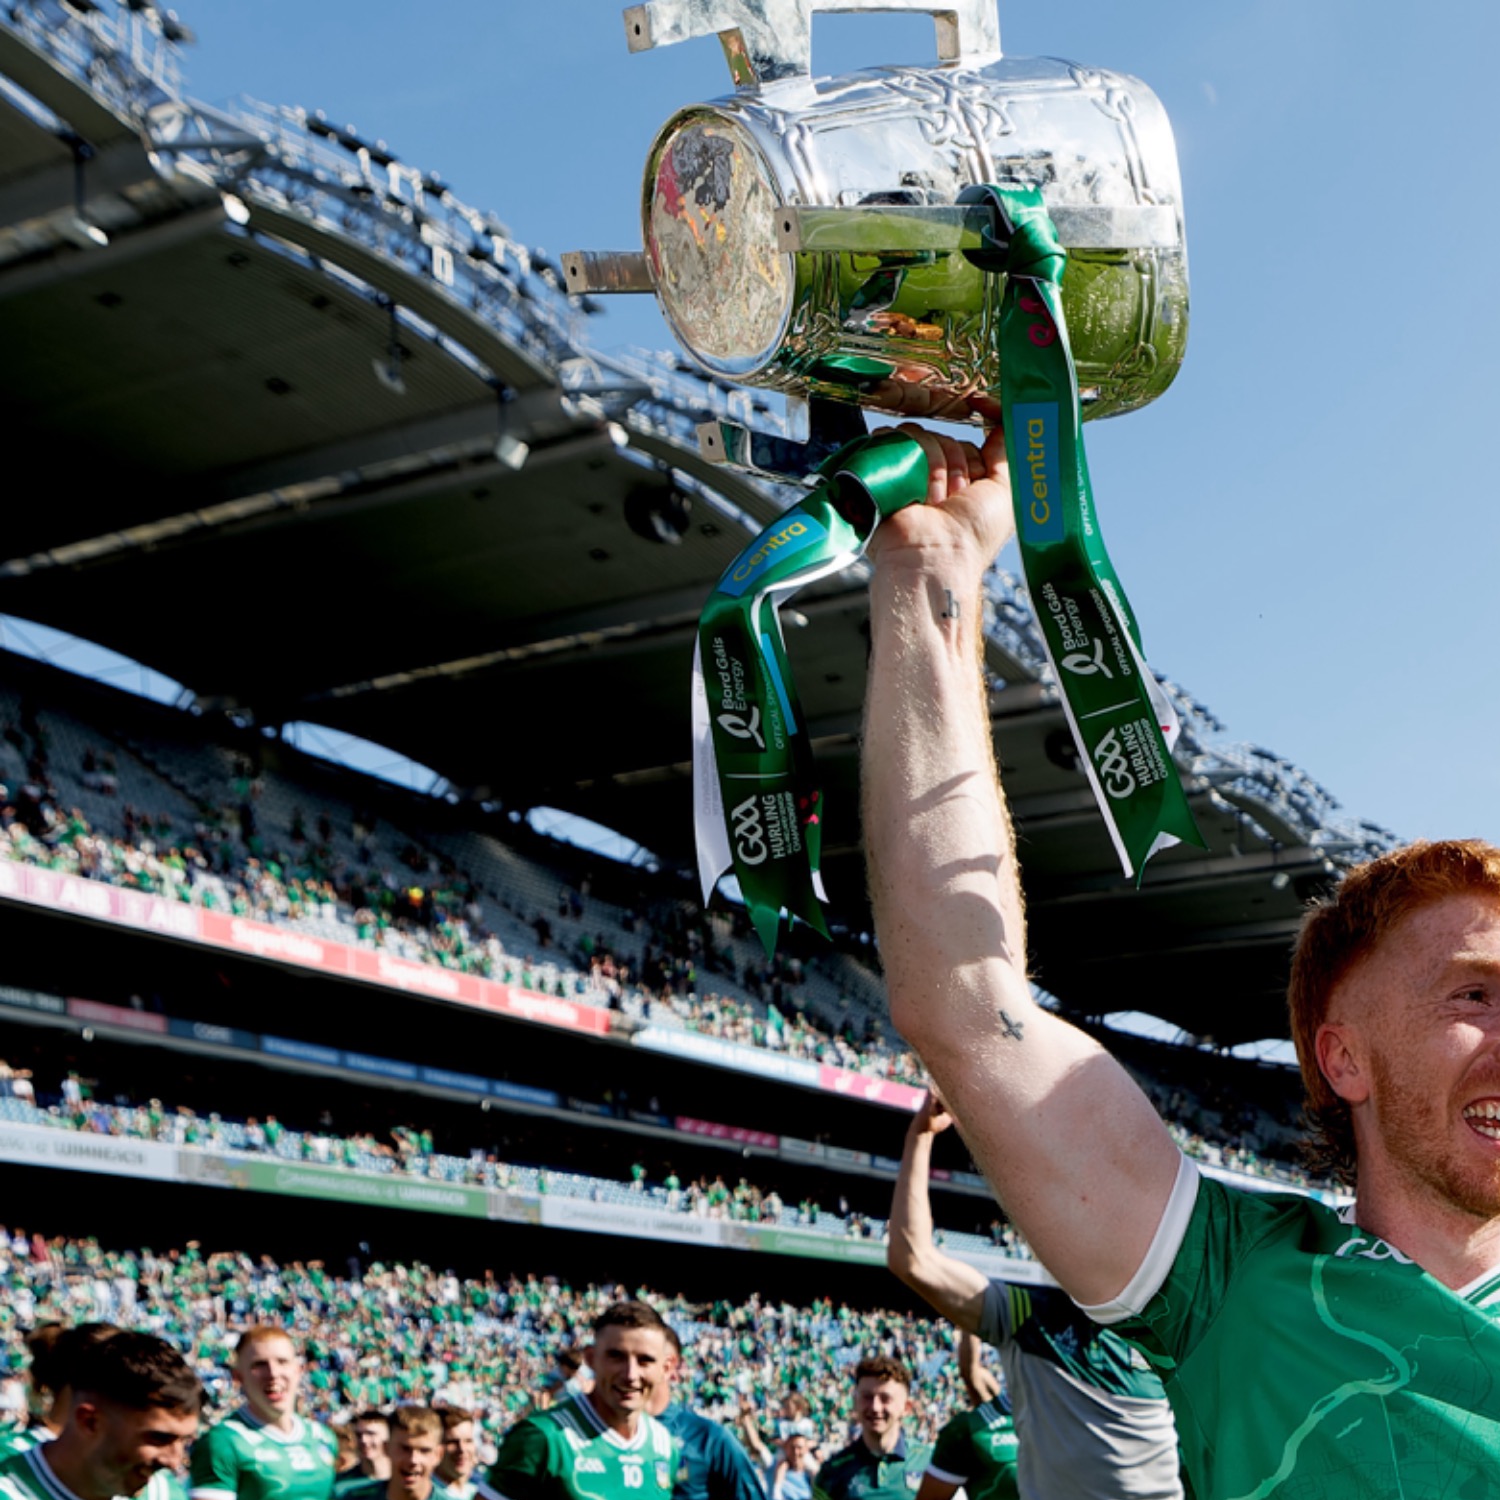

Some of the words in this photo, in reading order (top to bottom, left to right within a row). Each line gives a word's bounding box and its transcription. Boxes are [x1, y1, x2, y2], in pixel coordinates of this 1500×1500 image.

[1027, 417, 1046, 527] Centra
[731, 520, 809, 584] Centra
[1042, 582, 1063, 611] Gáis
[1062, 596, 1089, 648] Energy
[713, 636, 729, 668] Gáis
[1054, 612, 1076, 651] Bord
[1112, 634, 1131, 676] OFFICIAL
[721, 671, 734, 710] Bord
[730, 657, 748, 712] Energy
[1094, 727, 1136, 799] GAA
[1119, 723, 1153, 787] HURLING
[731, 794, 767, 865] GAA
[762, 794, 786, 859] HURLING
[622, 1463, 645, 1489] 10
